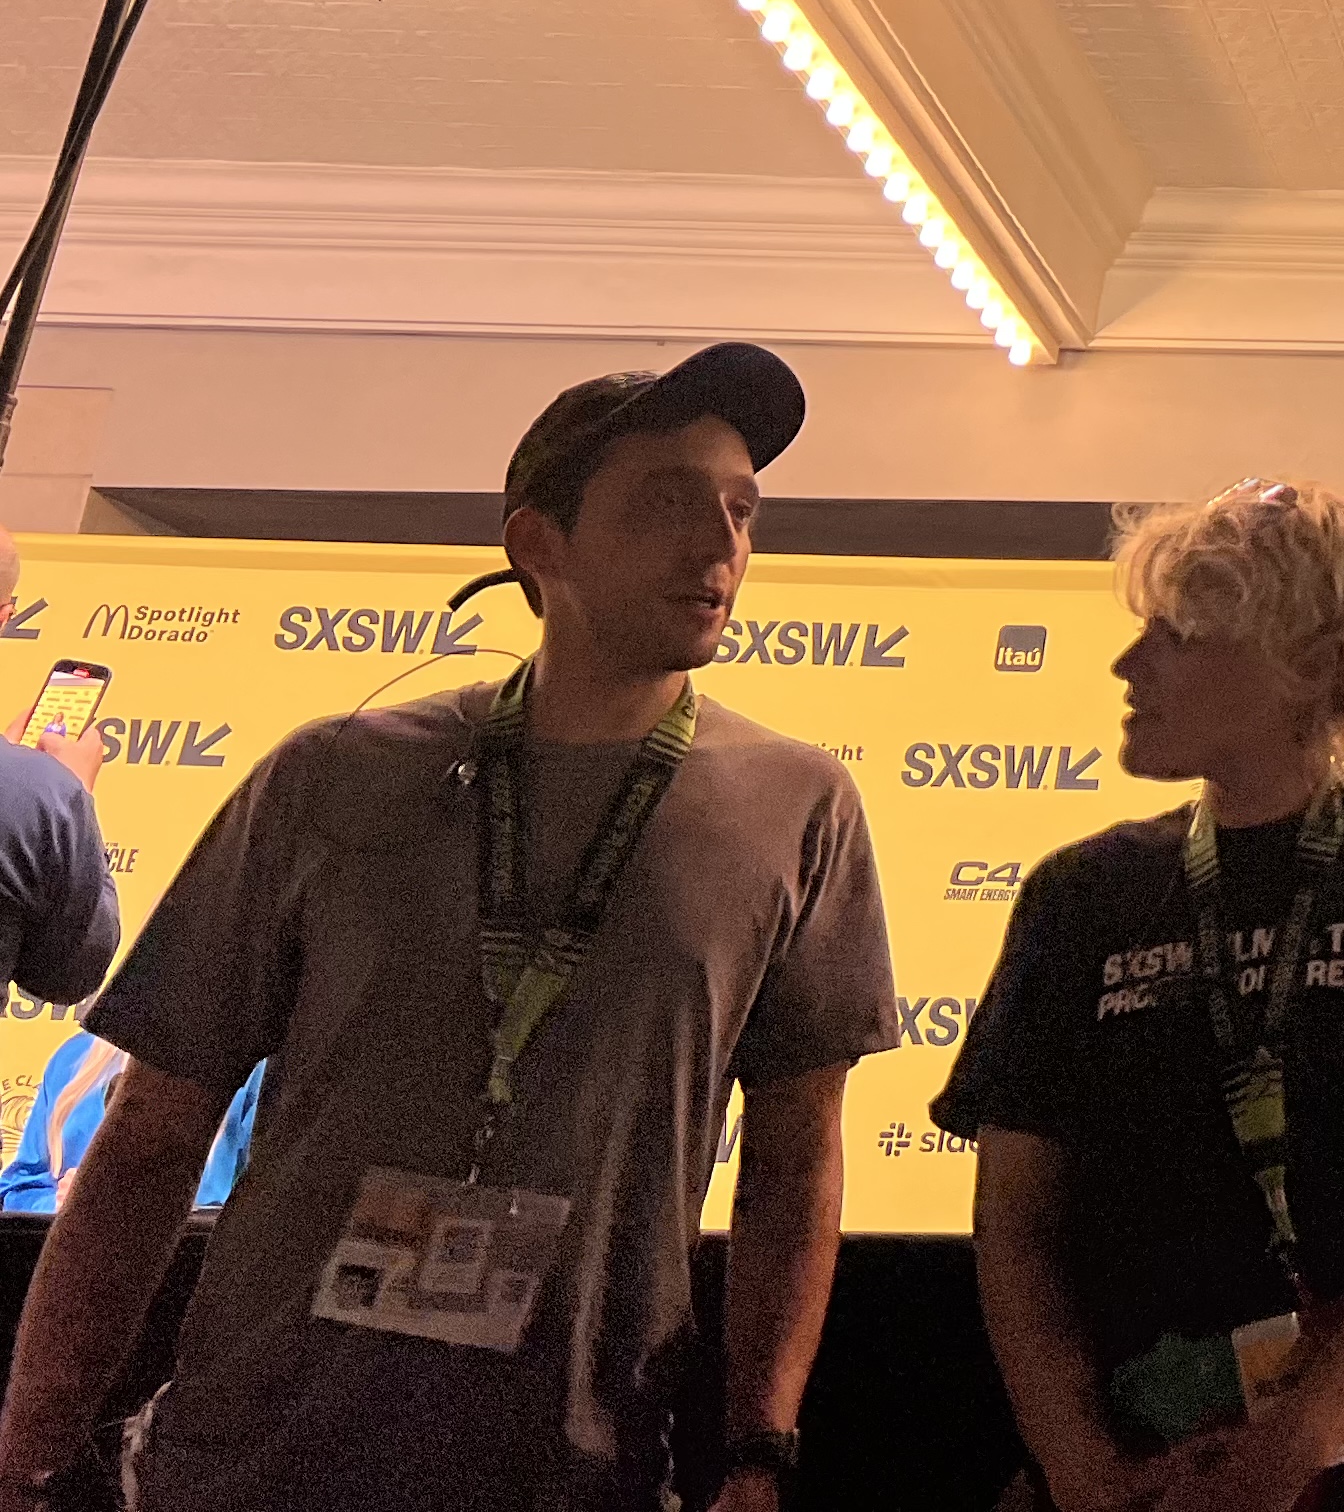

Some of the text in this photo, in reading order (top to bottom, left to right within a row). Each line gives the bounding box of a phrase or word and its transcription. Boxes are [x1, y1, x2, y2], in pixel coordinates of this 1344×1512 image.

[133, 604, 241, 626] Spotlight
[126, 625, 209, 643] Dorado
[274, 605, 436, 654] SXSW
[714, 619, 861, 667] SXSW
[996, 646, 1042, 666] Itaú
[901, 742, 1054, 790] SXSW
[950, 861, 1022, 887] C4
[943, 888, 980, 901] SMART
